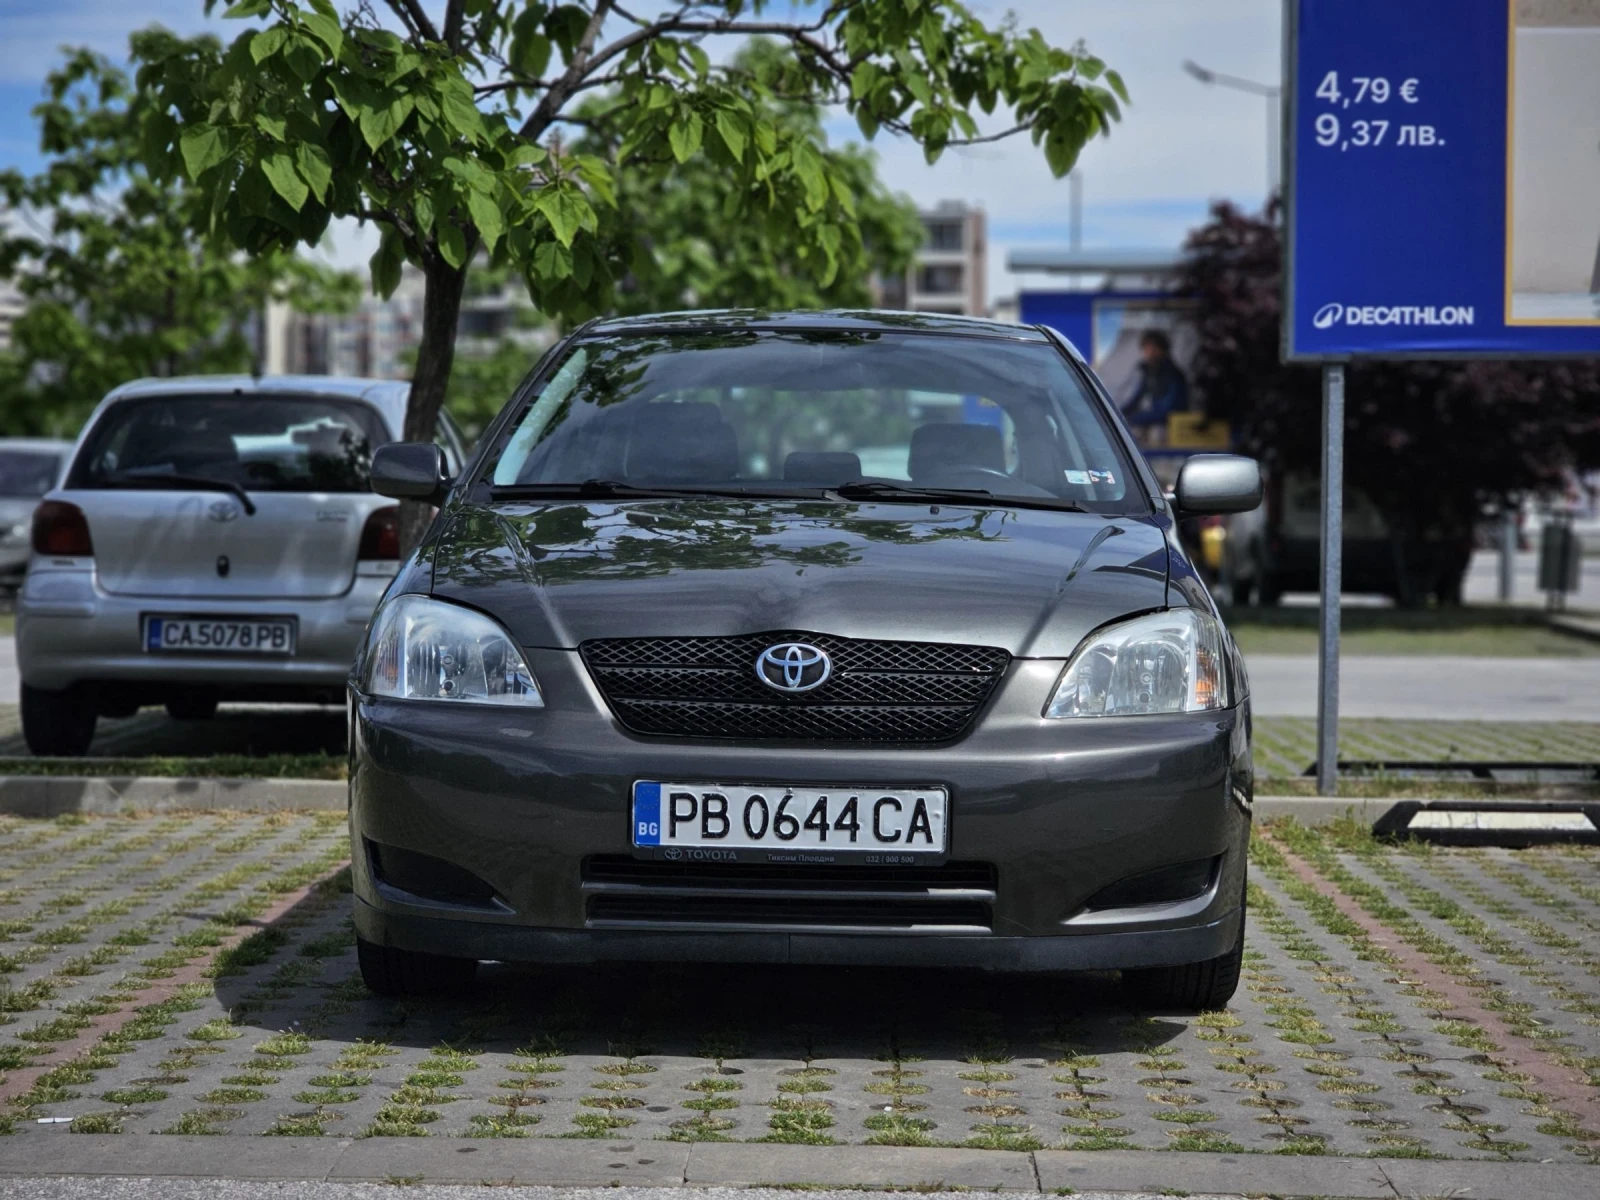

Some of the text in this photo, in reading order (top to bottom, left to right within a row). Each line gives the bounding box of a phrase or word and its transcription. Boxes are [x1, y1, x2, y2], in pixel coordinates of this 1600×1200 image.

[1315, 71, 1419, 109] 4,79 €
[1315, 113, 1446, 151] 9,37 лв.
[1346, 306, 1475, 326] DECATHLON
[668, 792, 934, 844] PB 0644 CA
[638, 822, 658, 836] BG
[685, 849, 737, 860] TOYOTA
[798, 854, 835, 863] Пловдив
[865, 855, 880, 863] 032
